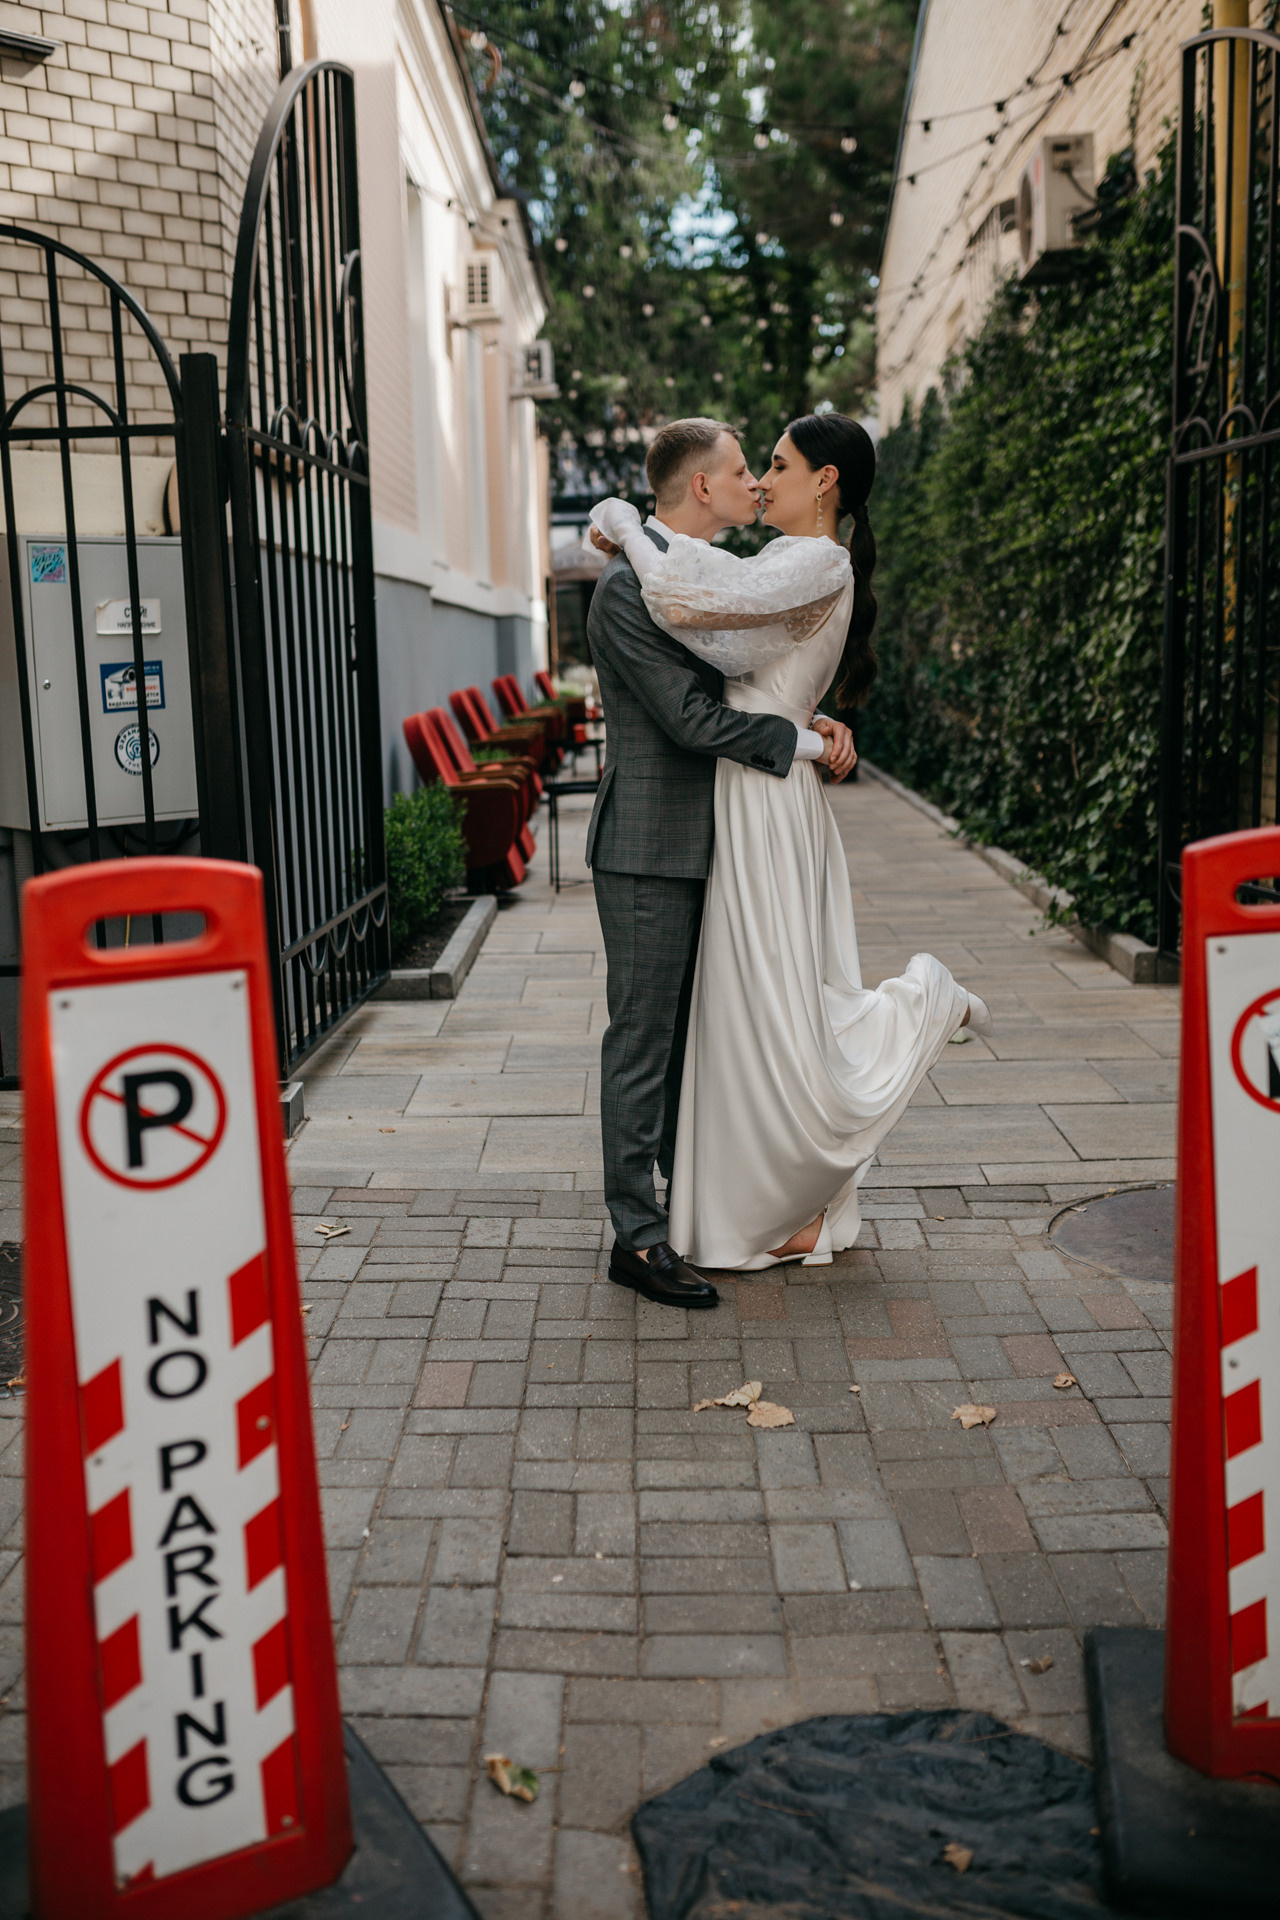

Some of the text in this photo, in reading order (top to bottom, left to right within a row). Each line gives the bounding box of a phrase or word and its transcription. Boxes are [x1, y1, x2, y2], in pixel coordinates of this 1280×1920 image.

[123, 1069, 194, 1168] P
[148, 1290, 235, 1808] NO PARKING
